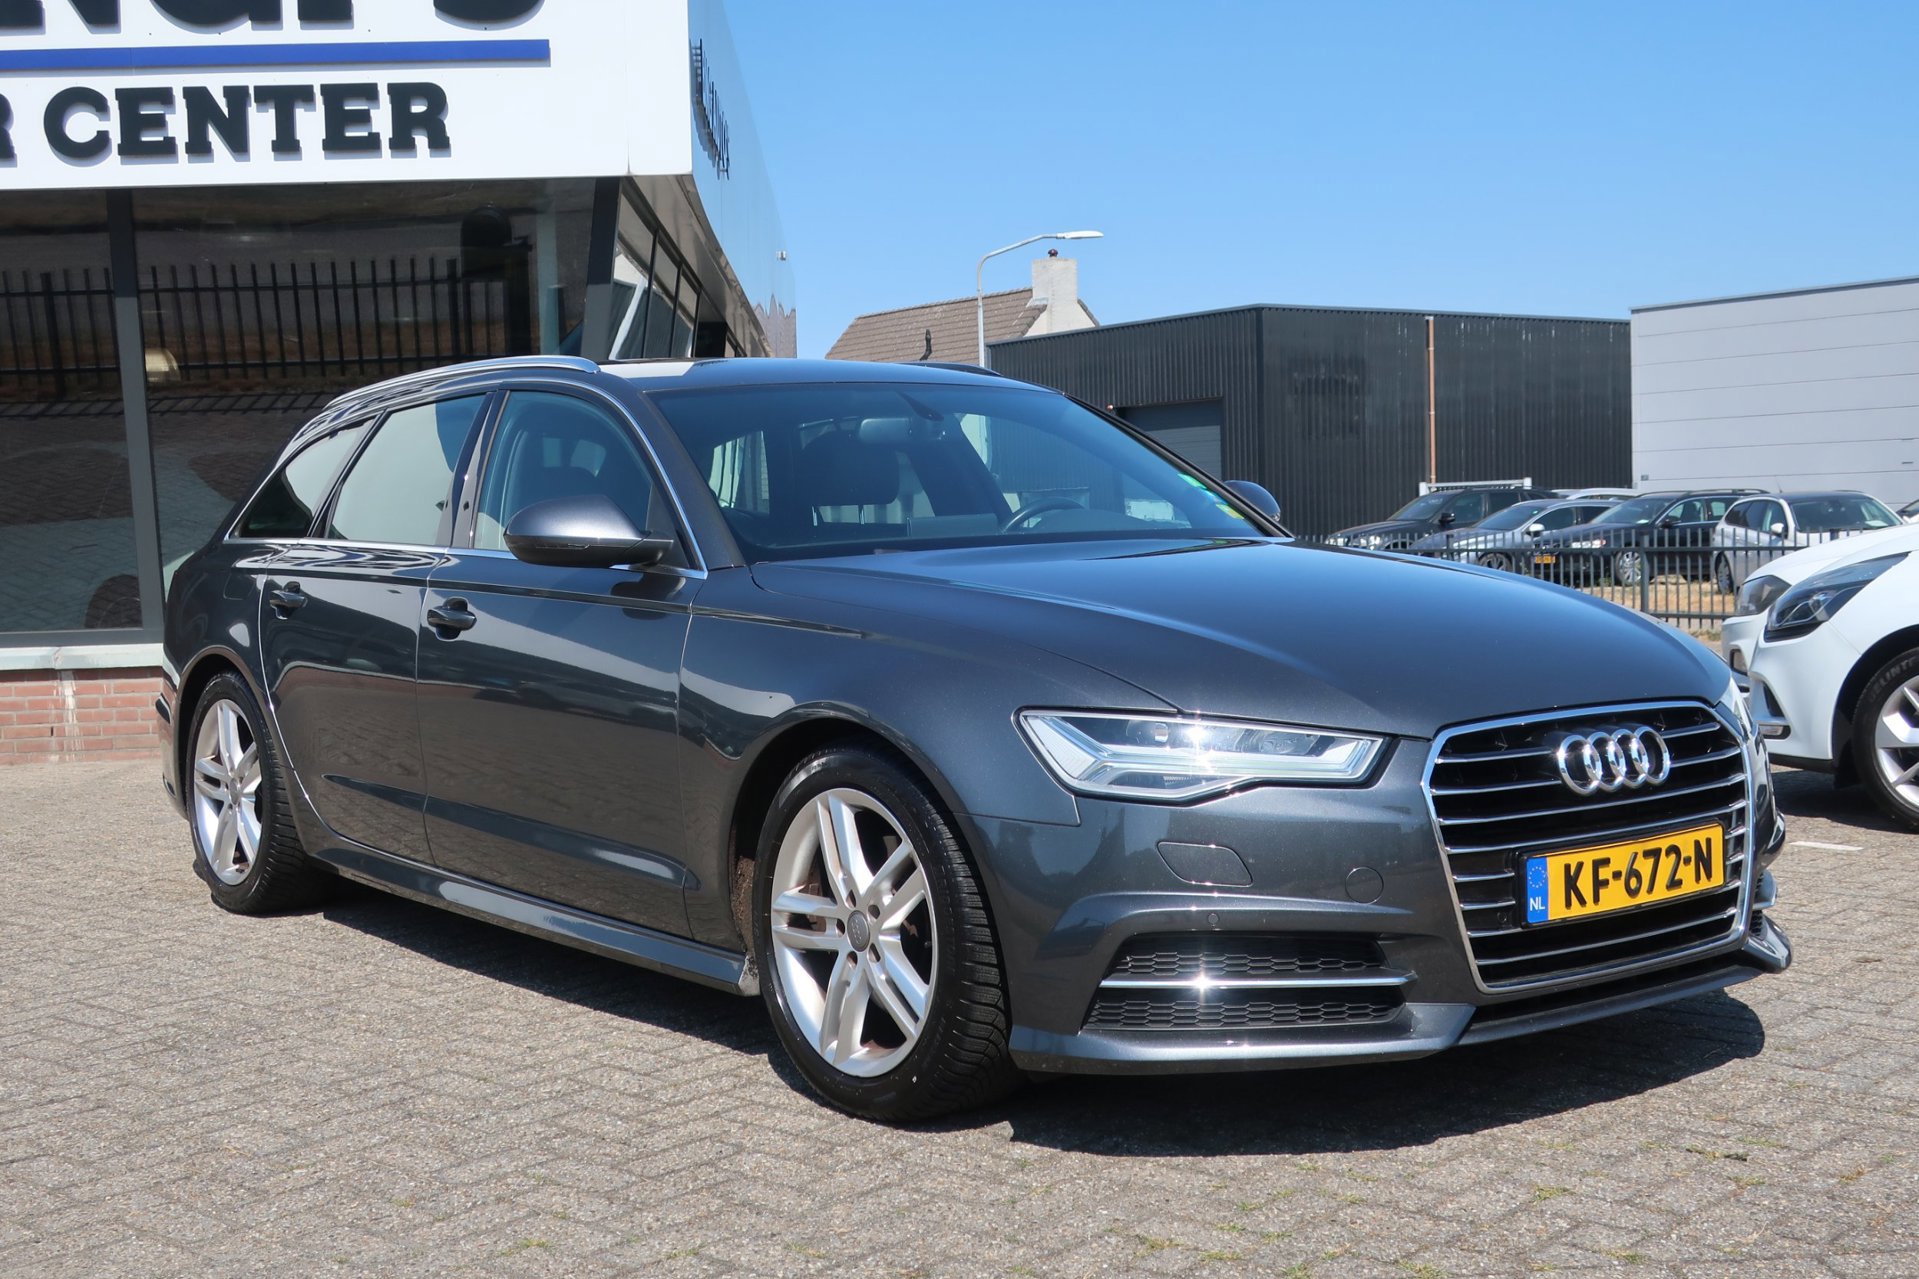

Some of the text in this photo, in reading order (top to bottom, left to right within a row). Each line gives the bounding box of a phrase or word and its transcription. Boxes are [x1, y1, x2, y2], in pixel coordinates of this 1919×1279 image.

[44, 82, 450, 158] CENTER
[1529, 896, 1546, 911] NL
[1564, 837, 1712, 910] KF-672-N
